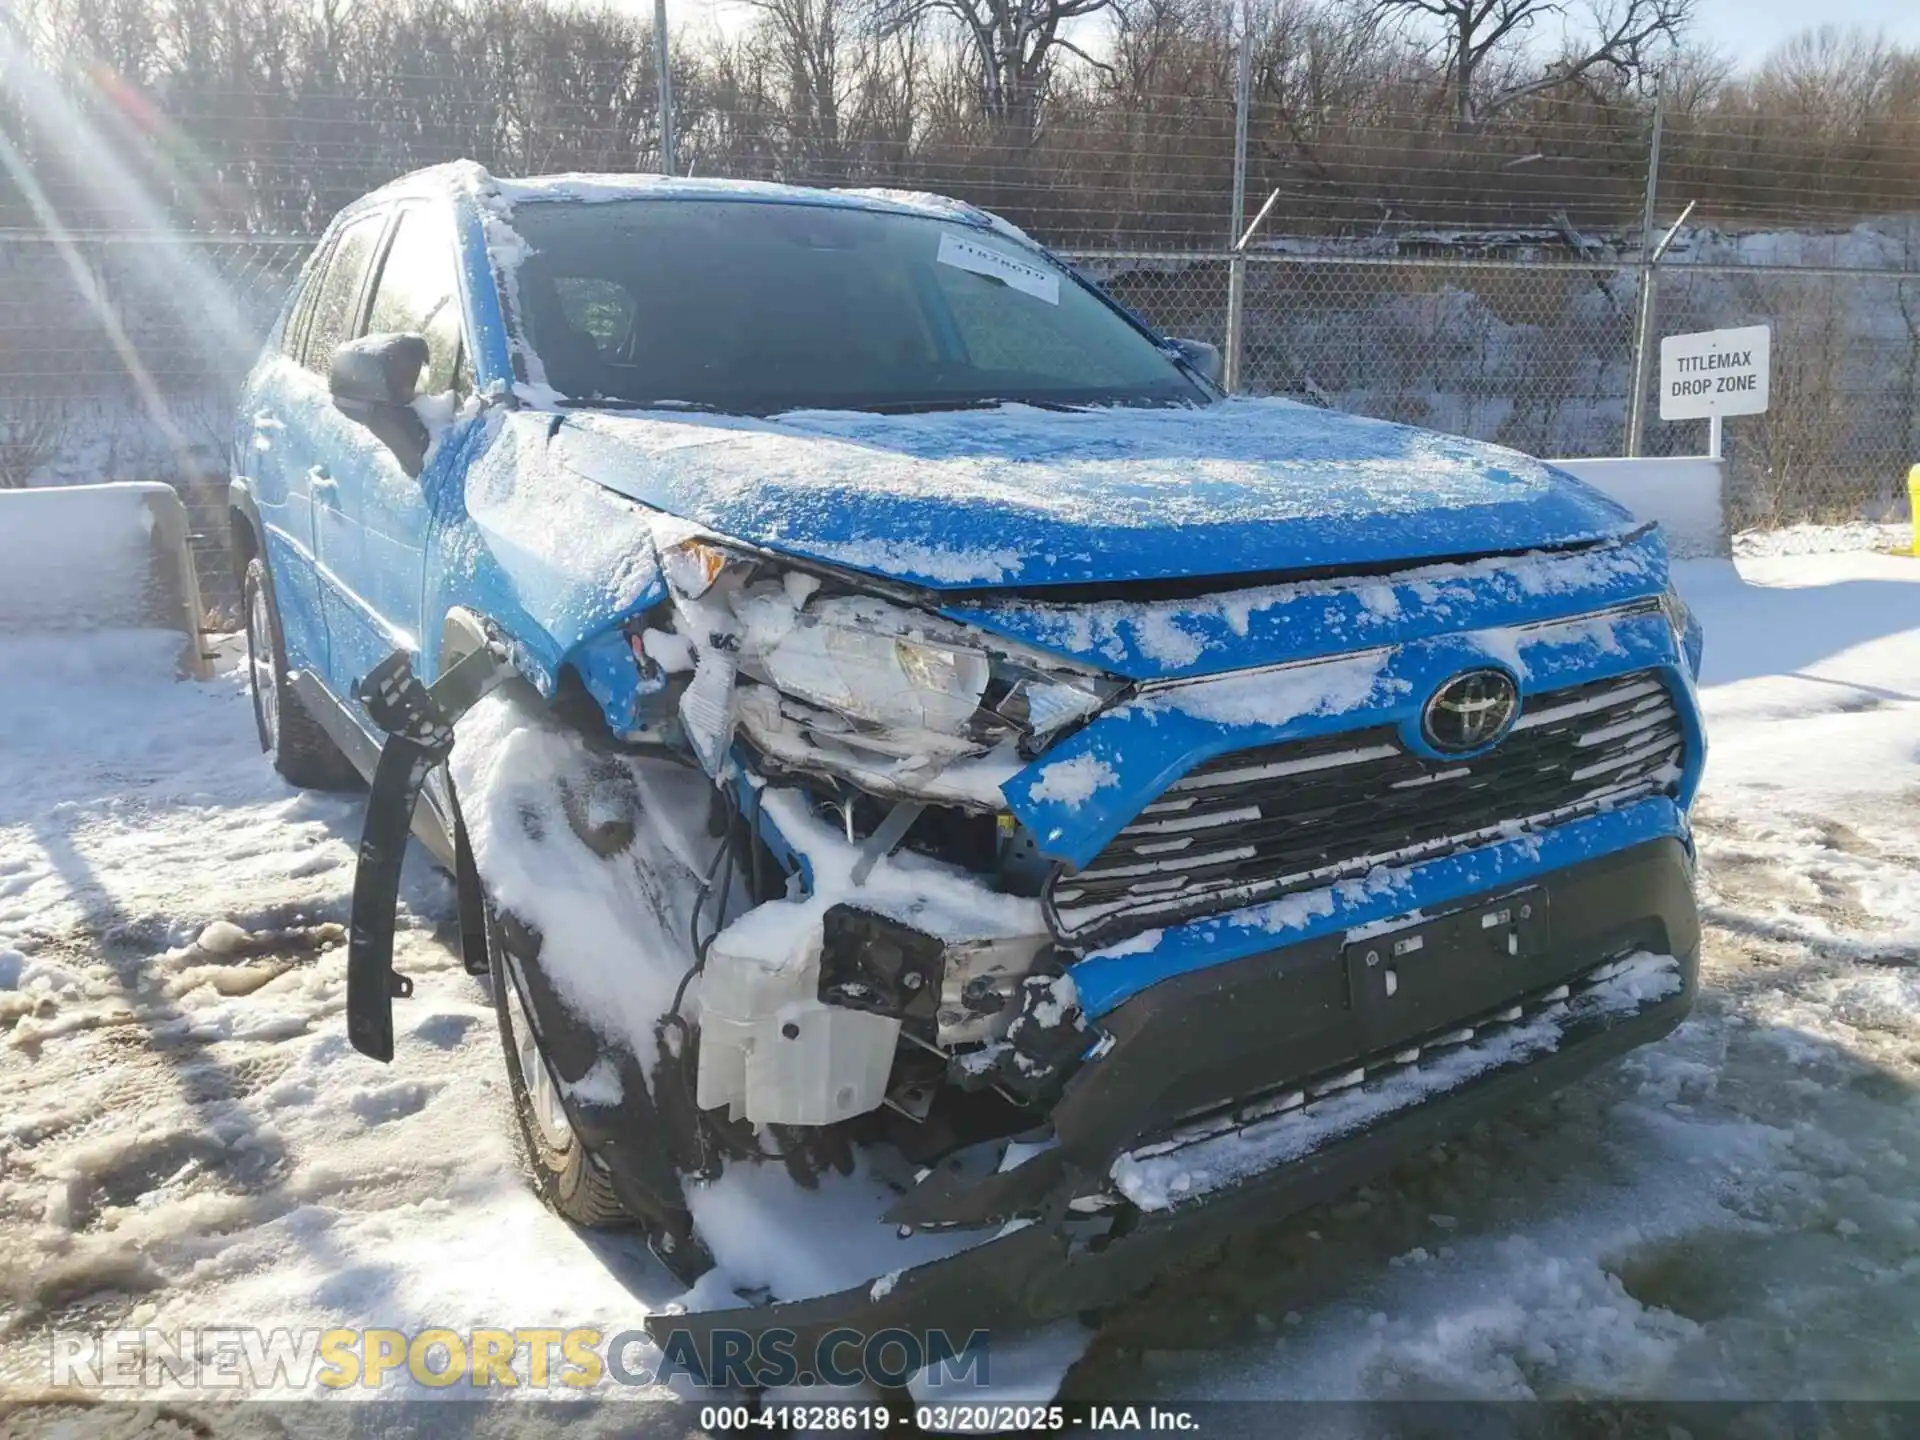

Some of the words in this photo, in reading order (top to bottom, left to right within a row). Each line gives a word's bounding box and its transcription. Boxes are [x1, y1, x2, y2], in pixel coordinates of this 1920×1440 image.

[1676, 350, 1752, 373] TITLEMAX
[1671, 378, 1712, 397] DROP
[1716, 374, 1757, 393] ZONE
